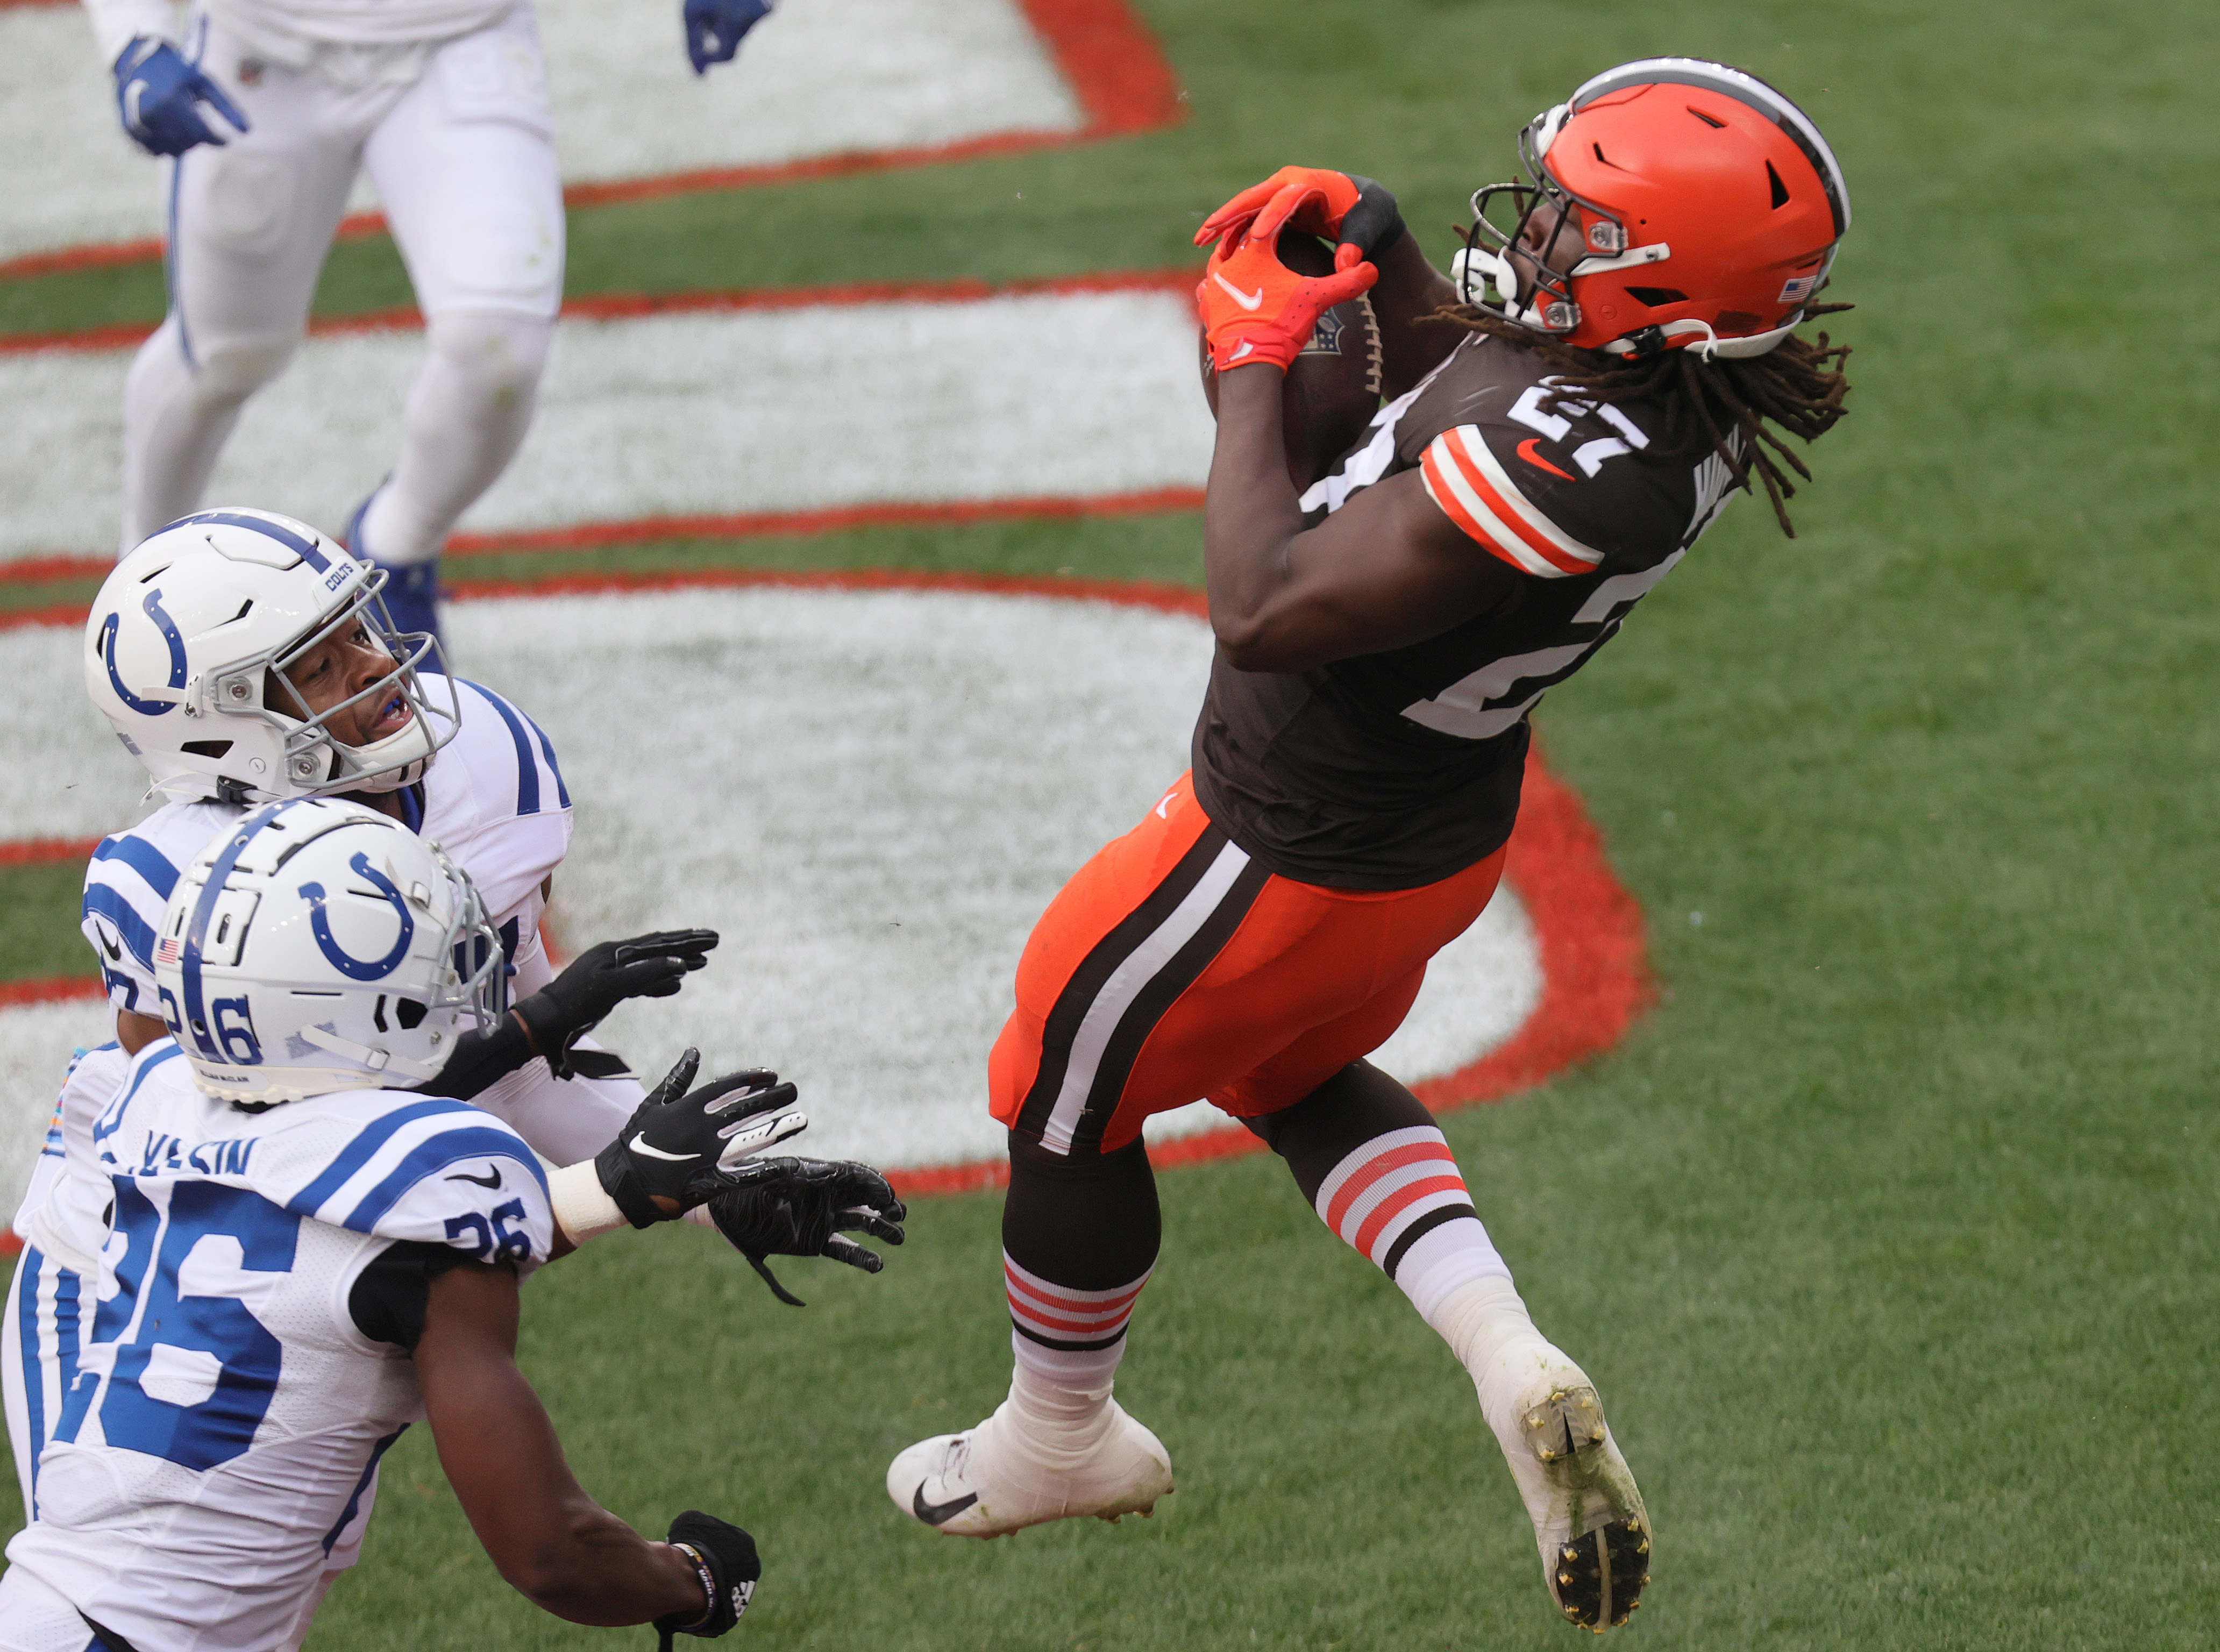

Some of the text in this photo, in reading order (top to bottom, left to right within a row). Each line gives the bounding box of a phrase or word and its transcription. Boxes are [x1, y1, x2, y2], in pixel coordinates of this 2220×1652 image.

[1506, 375, 1650, 480] 27
[325, 562, 354, 592] COLTS
[444, 1197, 527, 1264] 26
[51, 1174, 302, 1472] 26
